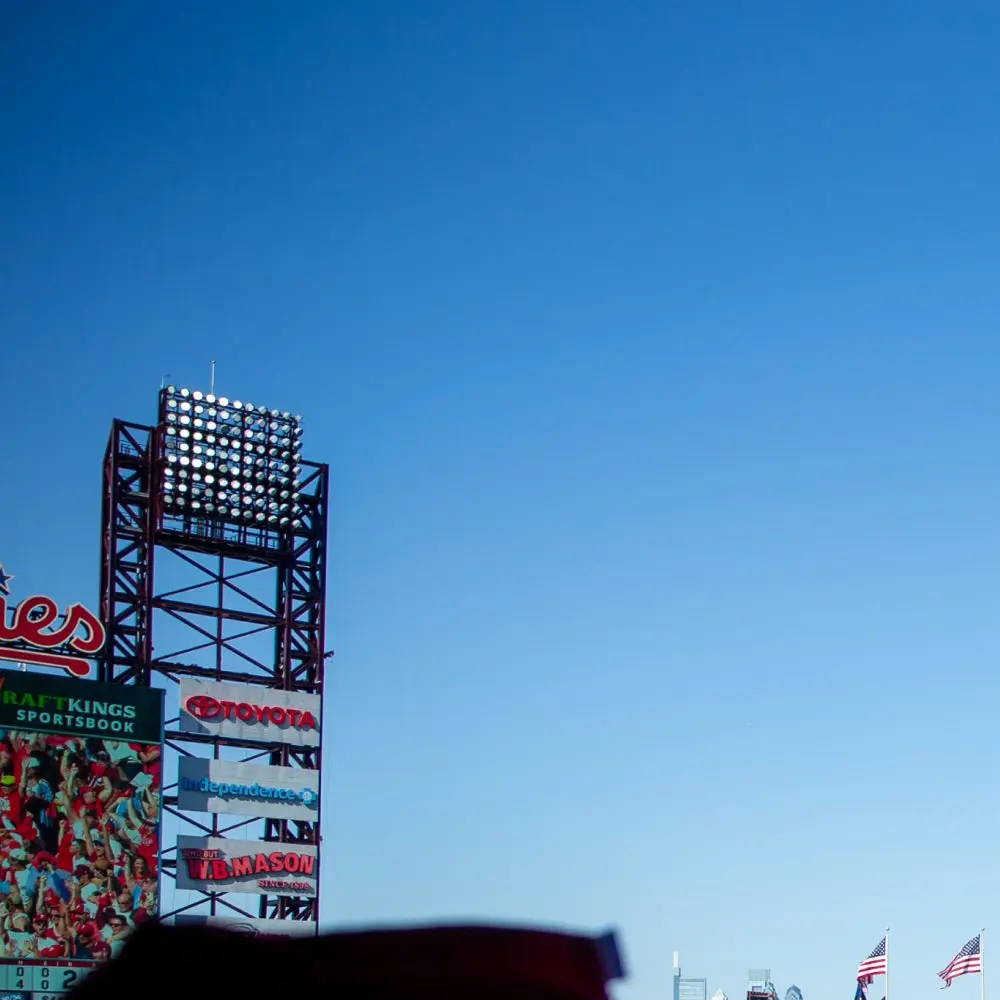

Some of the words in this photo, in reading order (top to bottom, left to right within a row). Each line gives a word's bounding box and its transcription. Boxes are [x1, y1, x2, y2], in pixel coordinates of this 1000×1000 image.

[16, 709, 135, 733] SPORTSBOOK
[219, 701, 316, 729] TOYOTA
[203, 850, 219, 858] BUT
[257, 879, 288, 888] SINCE
